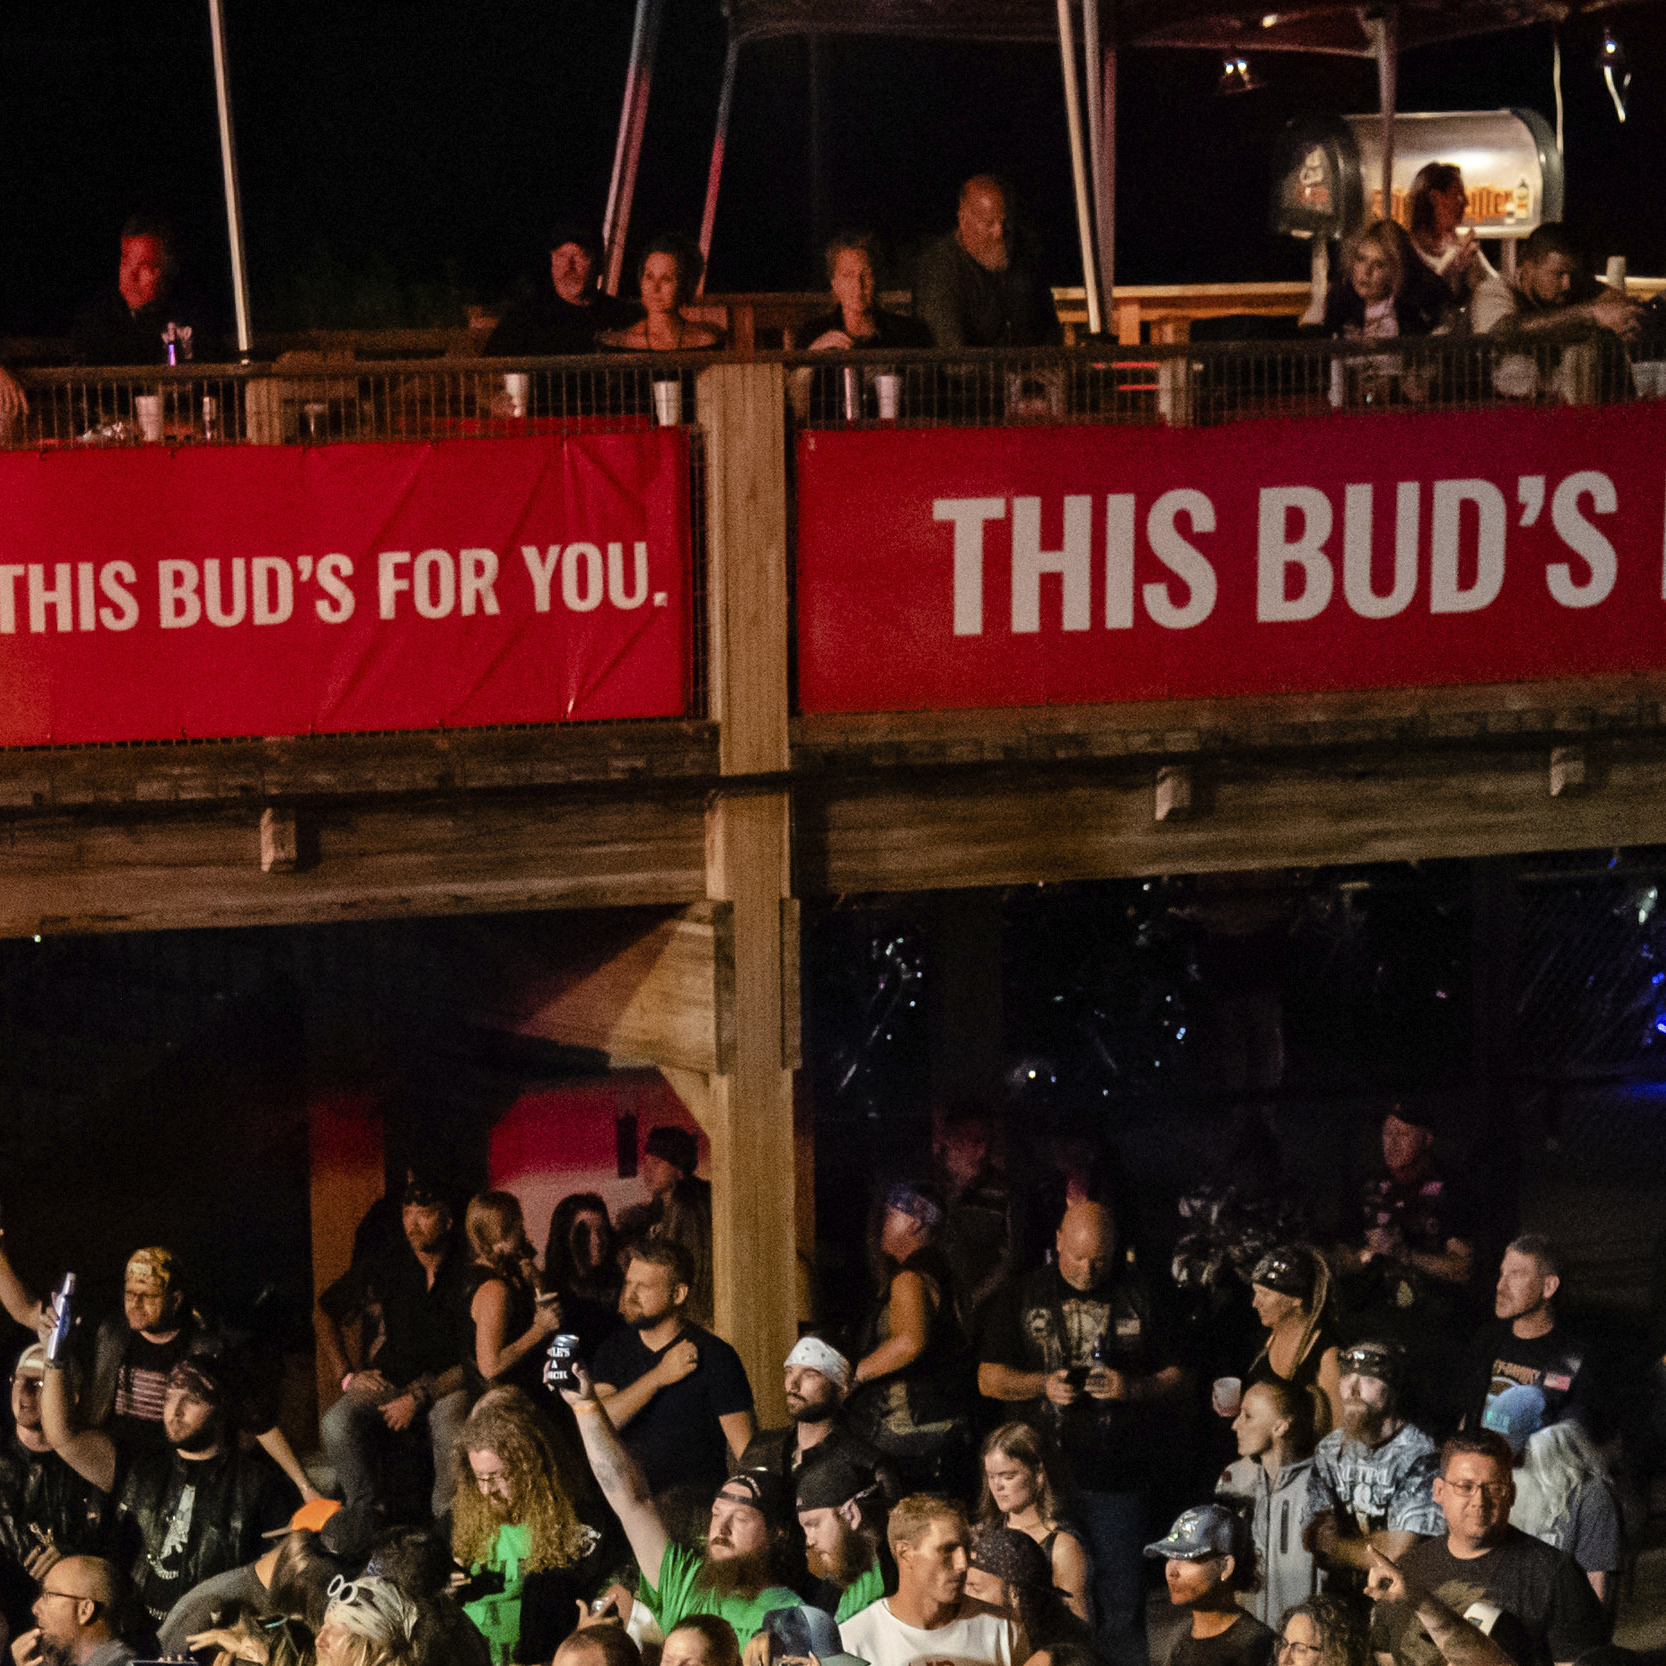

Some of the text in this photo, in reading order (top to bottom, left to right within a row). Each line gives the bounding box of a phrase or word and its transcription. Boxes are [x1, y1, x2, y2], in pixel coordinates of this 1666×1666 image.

[157, 552, 356, 630] BUD'S
[377, 547, 501, 621] FOR
[521, 540, 669, 613] YOU.
[932, 488, 1219, 636] THIS
[1254, 470, 1620, 624] BUD'S
